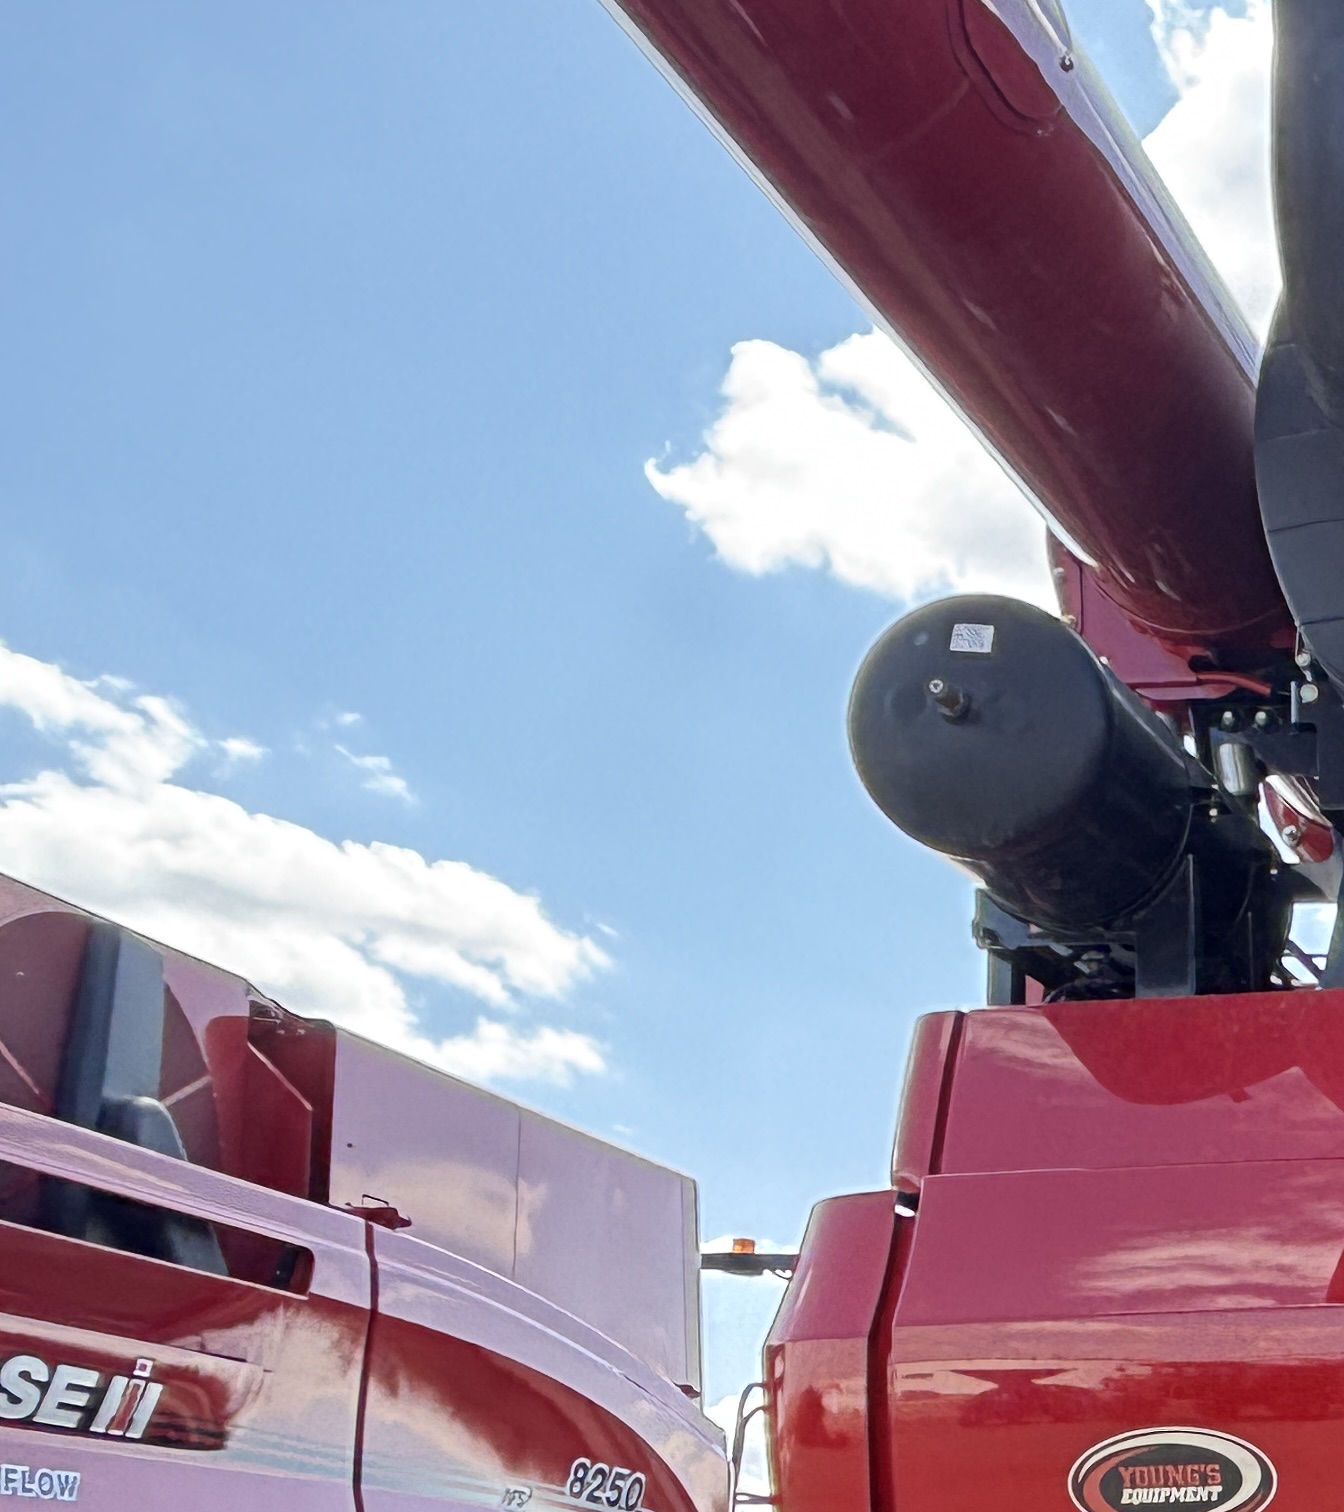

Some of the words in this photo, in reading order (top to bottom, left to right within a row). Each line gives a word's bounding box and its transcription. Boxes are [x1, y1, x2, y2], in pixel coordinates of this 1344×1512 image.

[567, 1458, 646, 1512] 8250
[1118, 1463, 1222, 1487] YOUNG'S
[1120, 1485, 1224, 1506] EQUIPMENT
